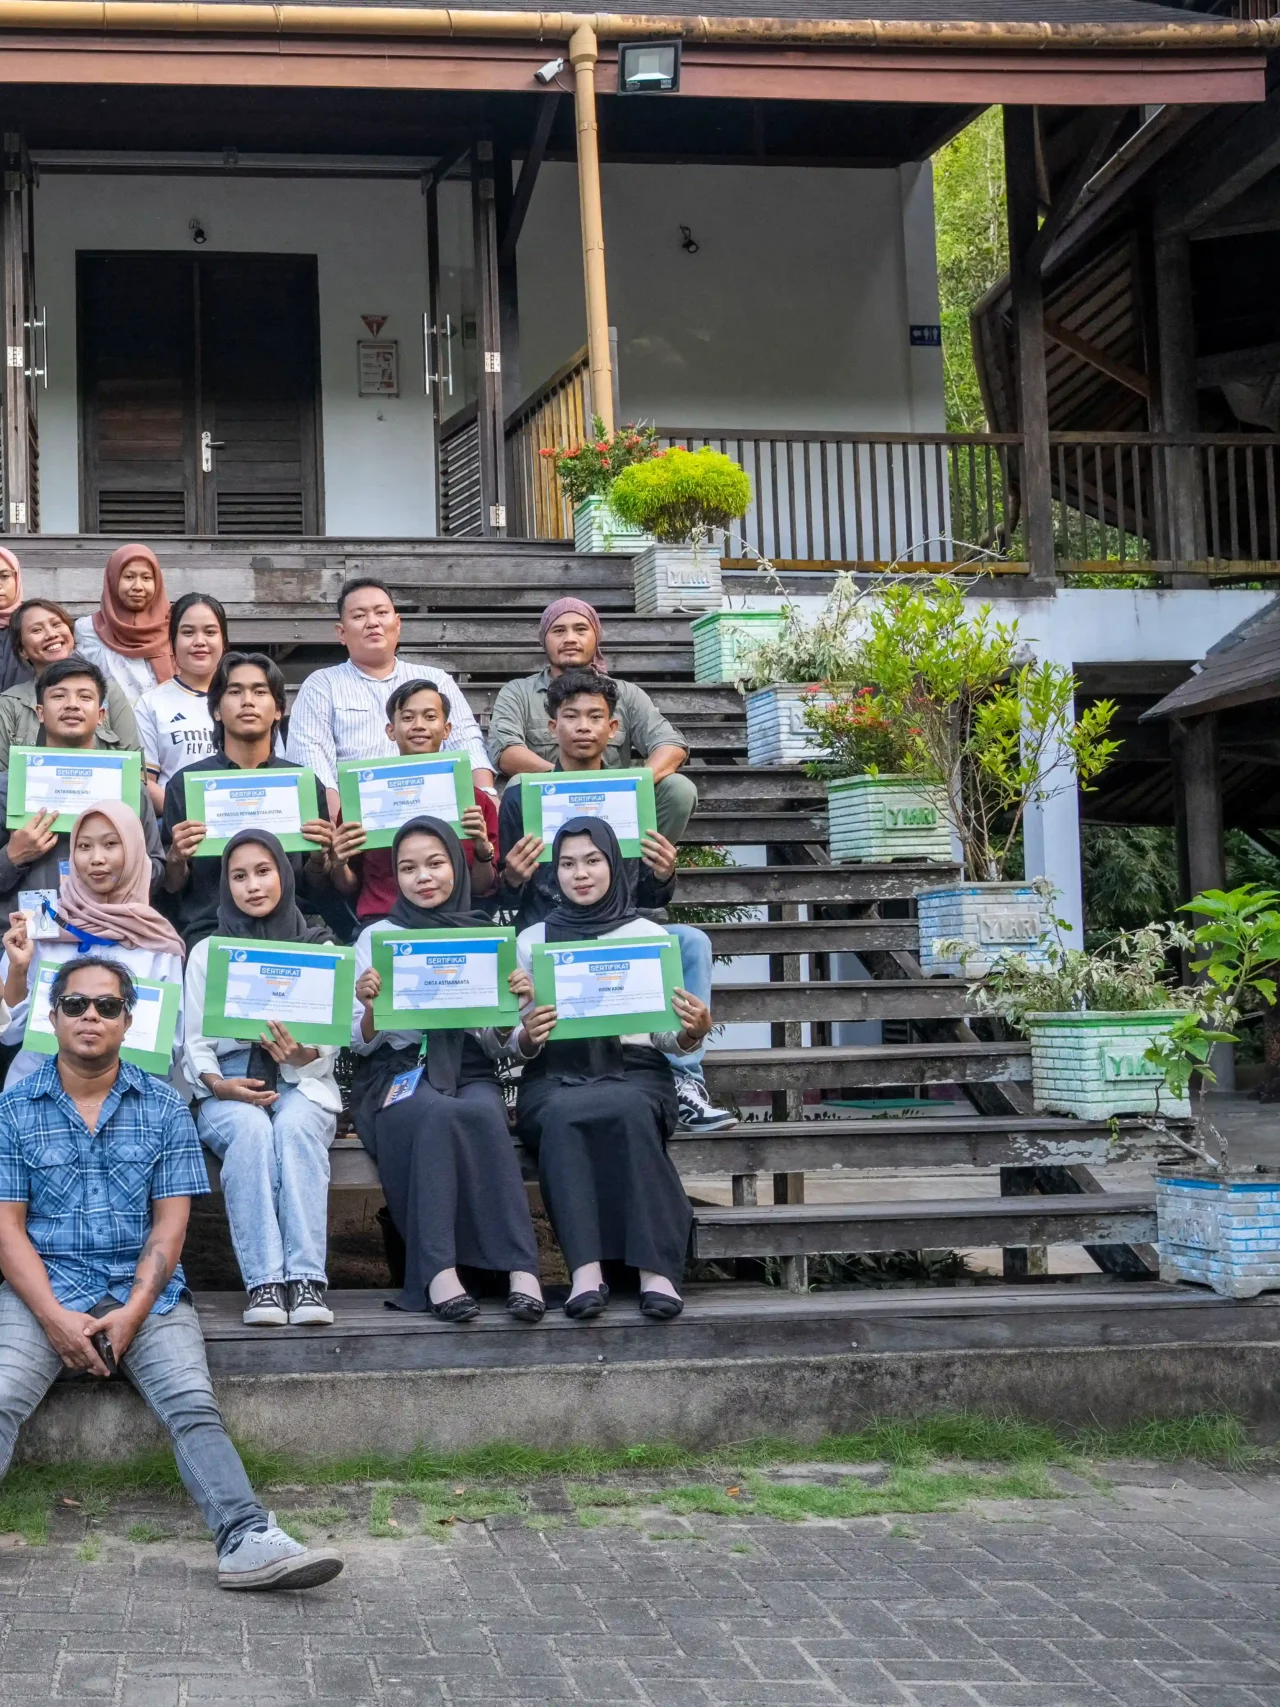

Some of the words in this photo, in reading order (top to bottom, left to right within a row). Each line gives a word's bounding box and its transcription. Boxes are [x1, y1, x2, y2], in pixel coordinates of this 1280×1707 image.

[186, 743, 203, 755] FLY
[57, 769, 93, 777] SERTIFIKAT
[388, 777, 425, 788] SERTIFIKAT
[230, 789, 266, 799] SERTIFIKAT
[570, 794, 605, 803] SERTIFIKAT
[982, 919, 1039, 940] YIARI
[427, 956, 466, 965] SERTIFIKAT
[260, 966, 301, 977] SERTIFIKAT
[590, 962, 630, 972] SERTIFIKAT
